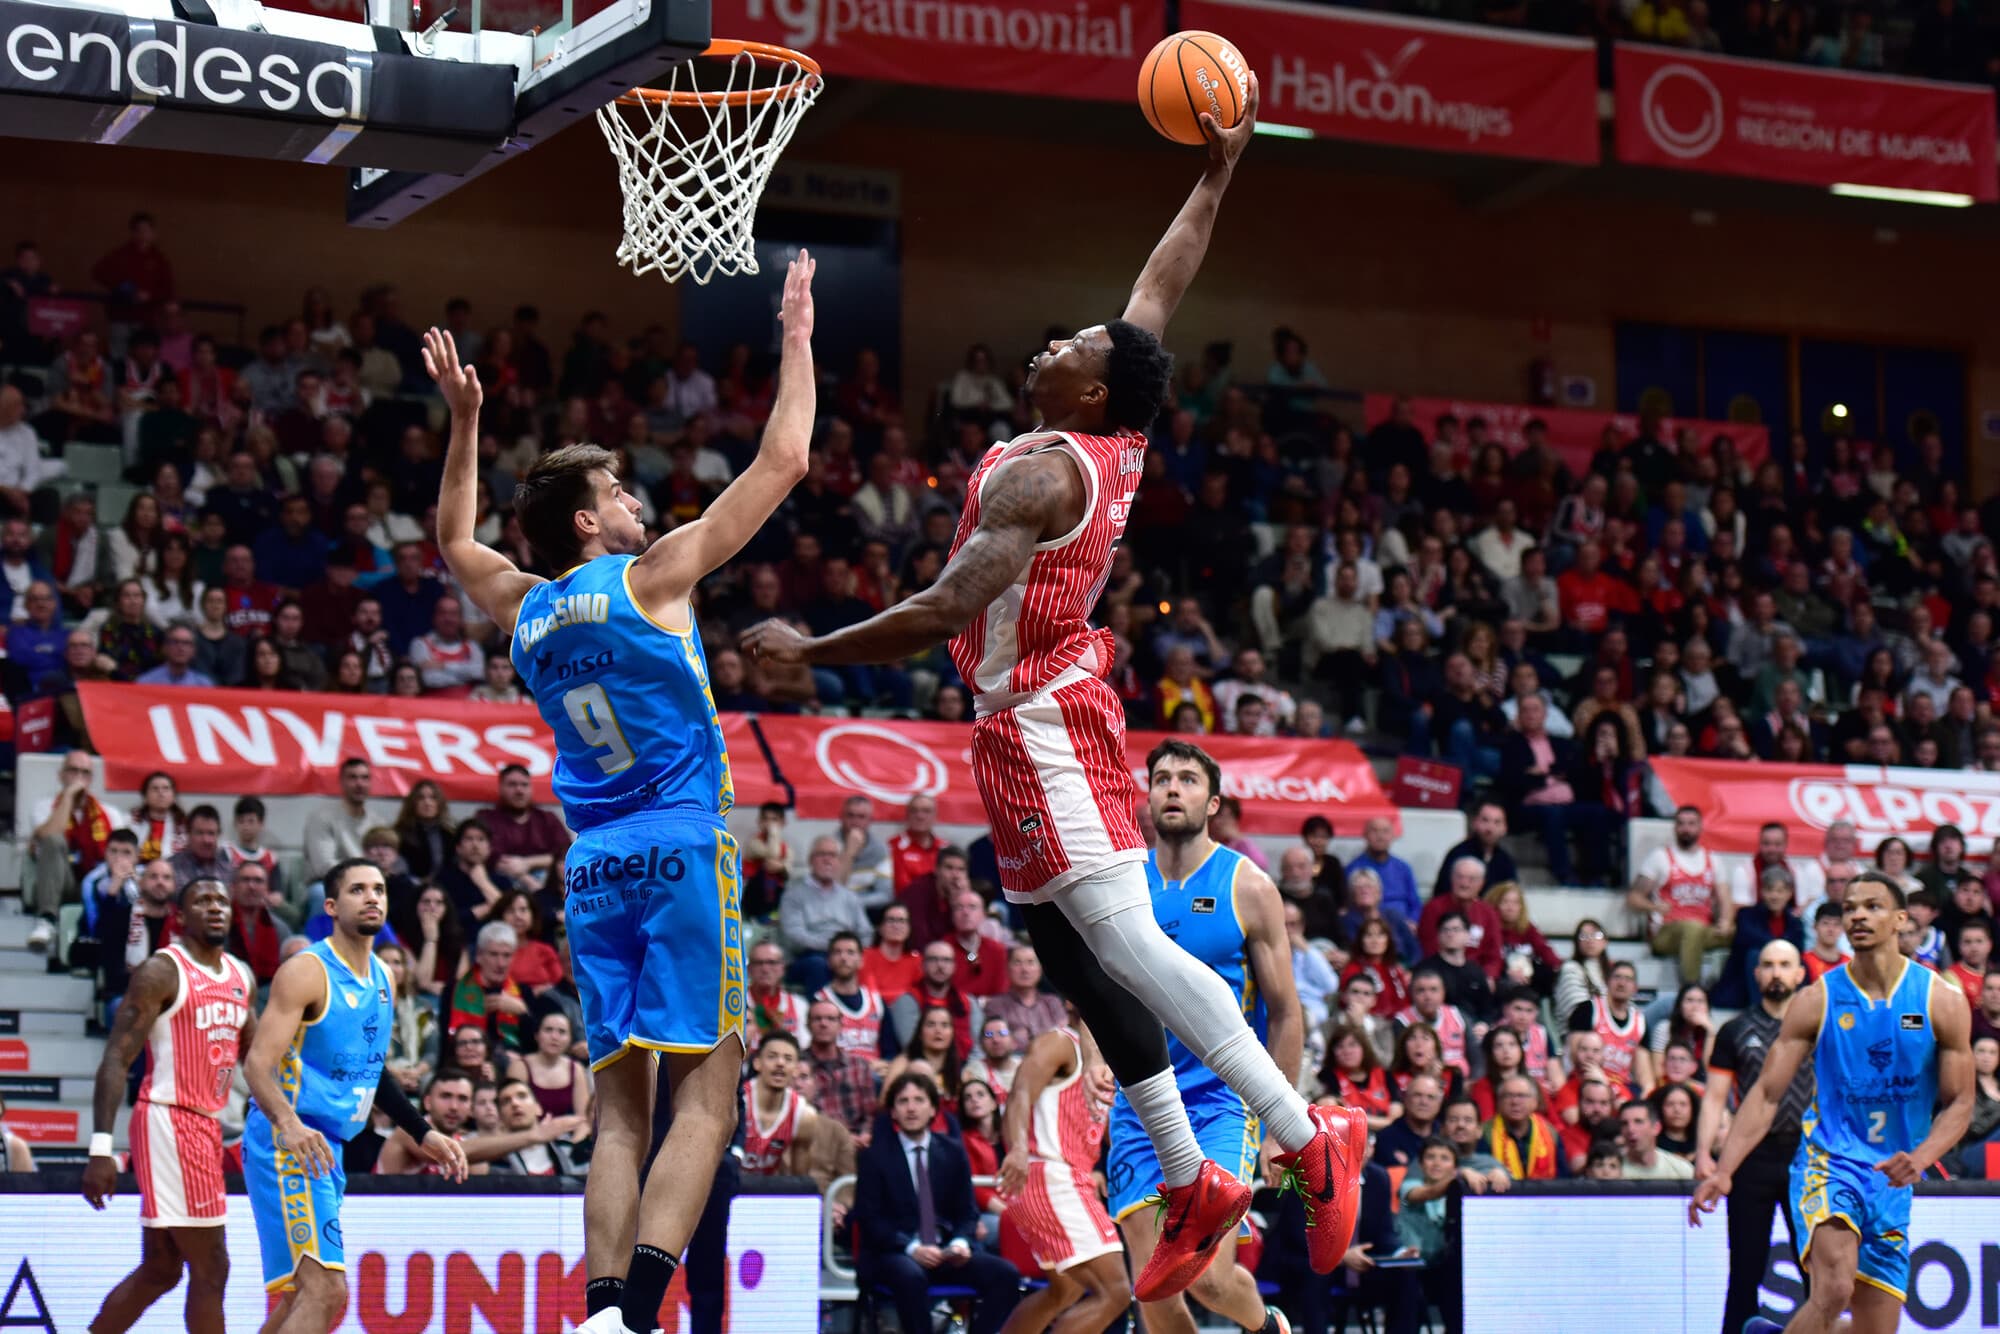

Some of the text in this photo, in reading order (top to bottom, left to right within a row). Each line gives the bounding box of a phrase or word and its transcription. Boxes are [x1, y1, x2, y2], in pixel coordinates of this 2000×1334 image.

[823, 0, 1135, 58] patrimonial
[6, 23, 363, 119] endesa
[1839, 127, 1873, 156] DE
[1878, 132, 1973, 165] MURCIA
[562, 682, 636, 774] 9
[572, 894, 615, 918] HOTEL
[1867, 1111, 1887, 1143] 2
